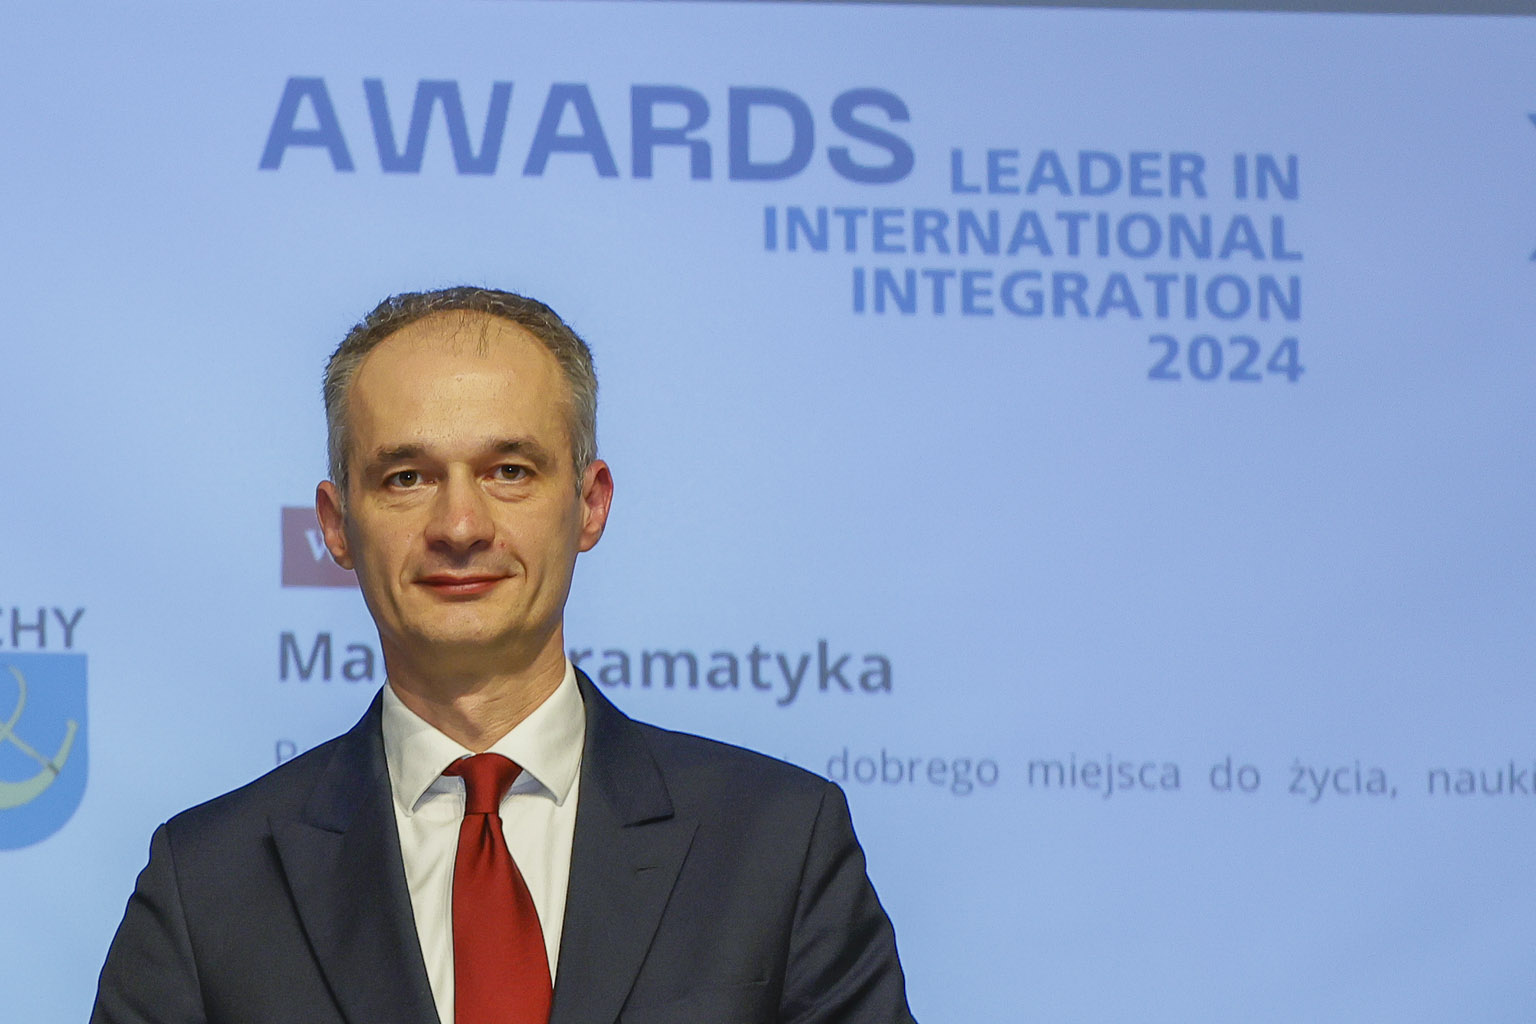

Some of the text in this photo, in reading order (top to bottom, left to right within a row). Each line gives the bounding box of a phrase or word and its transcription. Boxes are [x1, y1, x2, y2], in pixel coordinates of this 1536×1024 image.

[257, 75, 916, 185] AWARDS
[950, 147, 1300, 201] LEADER IN
[763, 205, 1304, 262] INTERNATIONAL
[851, 266, 1302, 322] INTEGRATION
[1146, 333, 1305, 384] 2024
[567, 638, 894, 708] ramatyka
[826, 746, 1000, 796] dobrego
[1028, 751, 1182, 799] miejsca
[1209, 754, 1262, 792] do
[1288, 757, 1400, 805] życia,
